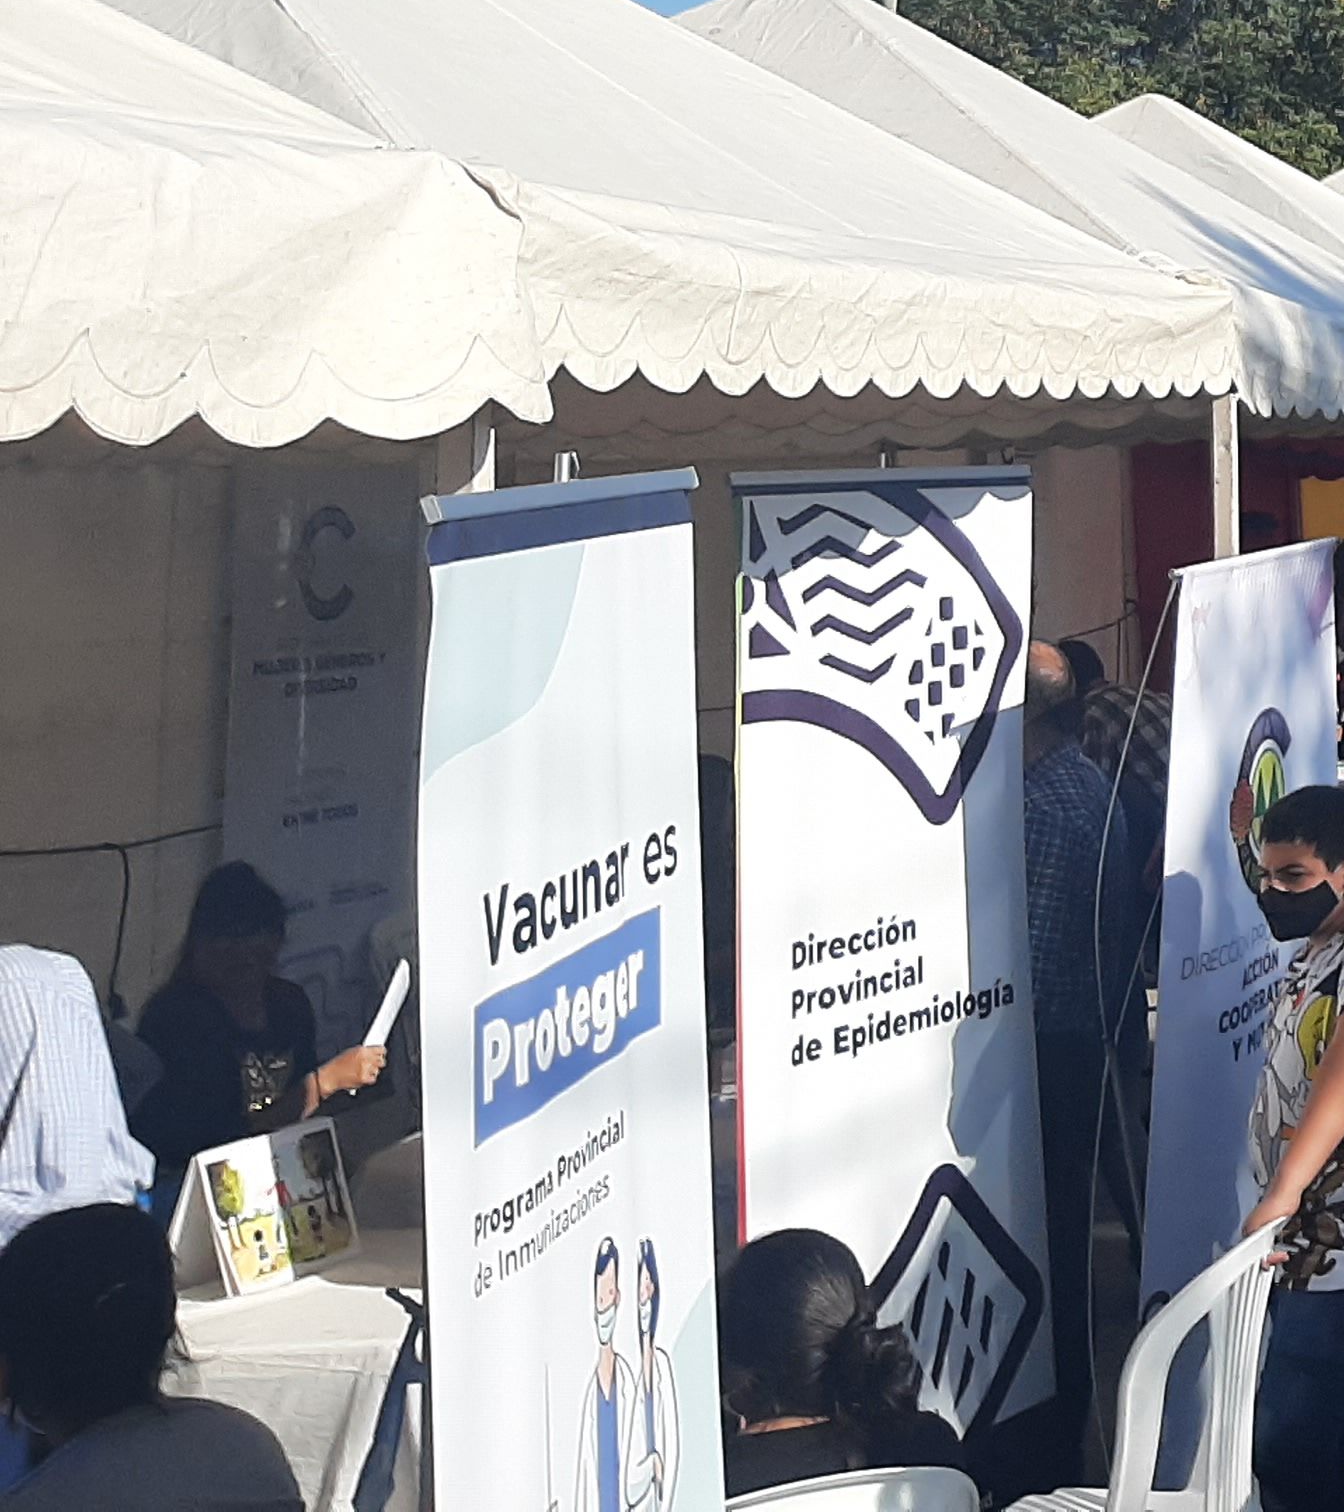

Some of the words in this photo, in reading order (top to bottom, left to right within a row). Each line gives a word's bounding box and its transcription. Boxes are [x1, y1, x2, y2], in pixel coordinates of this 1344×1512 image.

[483, 841, 630, 966] Vacunar
[643, 824, 678, 884] es
[792, 915, 916, 970] Dirección
[482, 949, 644, 1105] Proteger
[791, 1035, 823, 1067] de
[834, 978, 1015, 1058] Epidemiología
[792, 956, 924, 1019] Provincial
[474, 1170, 554, 1247] Programa
[557, 1109, 625, 1187] Provincial
[474, 1261, 493, 1298] de
[499, 1174, 610, 1281] Inmunizaciones
